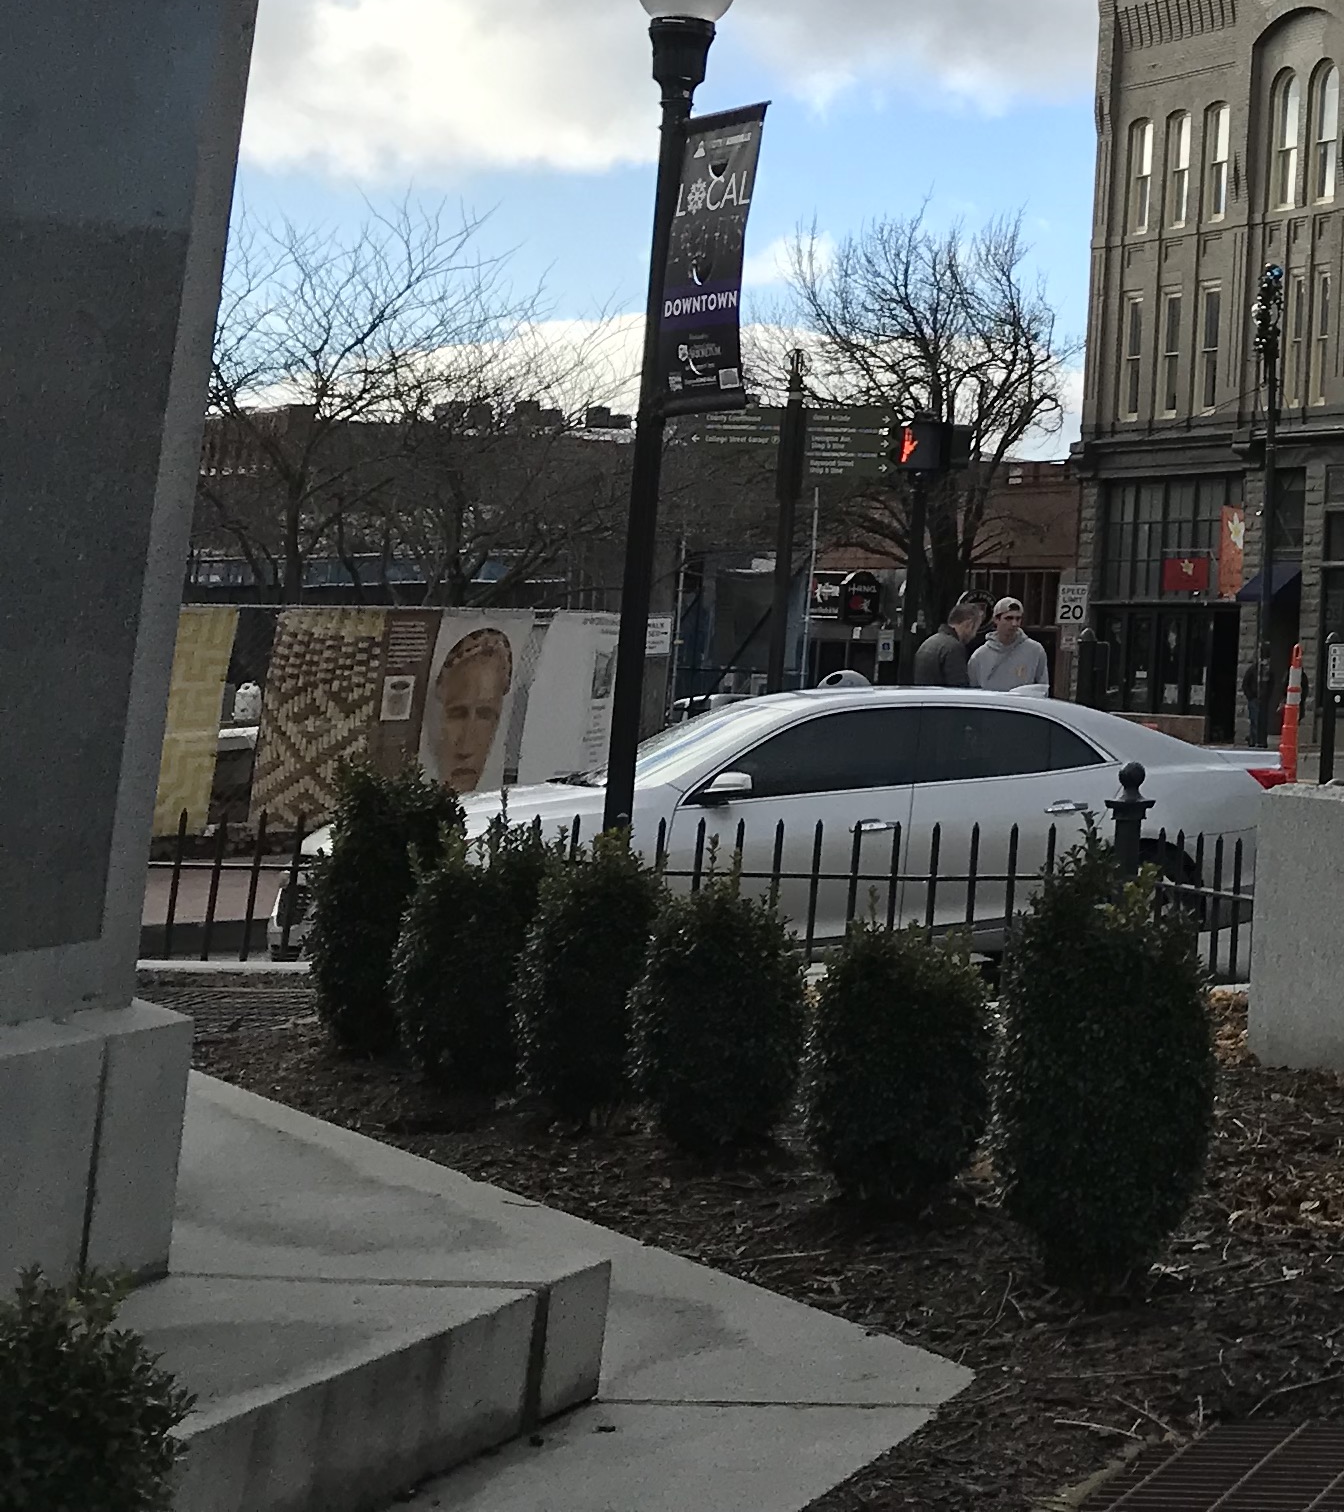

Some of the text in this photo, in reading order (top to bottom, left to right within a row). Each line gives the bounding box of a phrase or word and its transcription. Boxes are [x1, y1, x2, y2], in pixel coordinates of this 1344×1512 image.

[664, 290, 738, 318] DOWNTOWN
[1061, 587, 1087, 595] SPEED
[1063, 596, 1082, 604] LIMIT
[1060, 604, 1083, 620] 20
